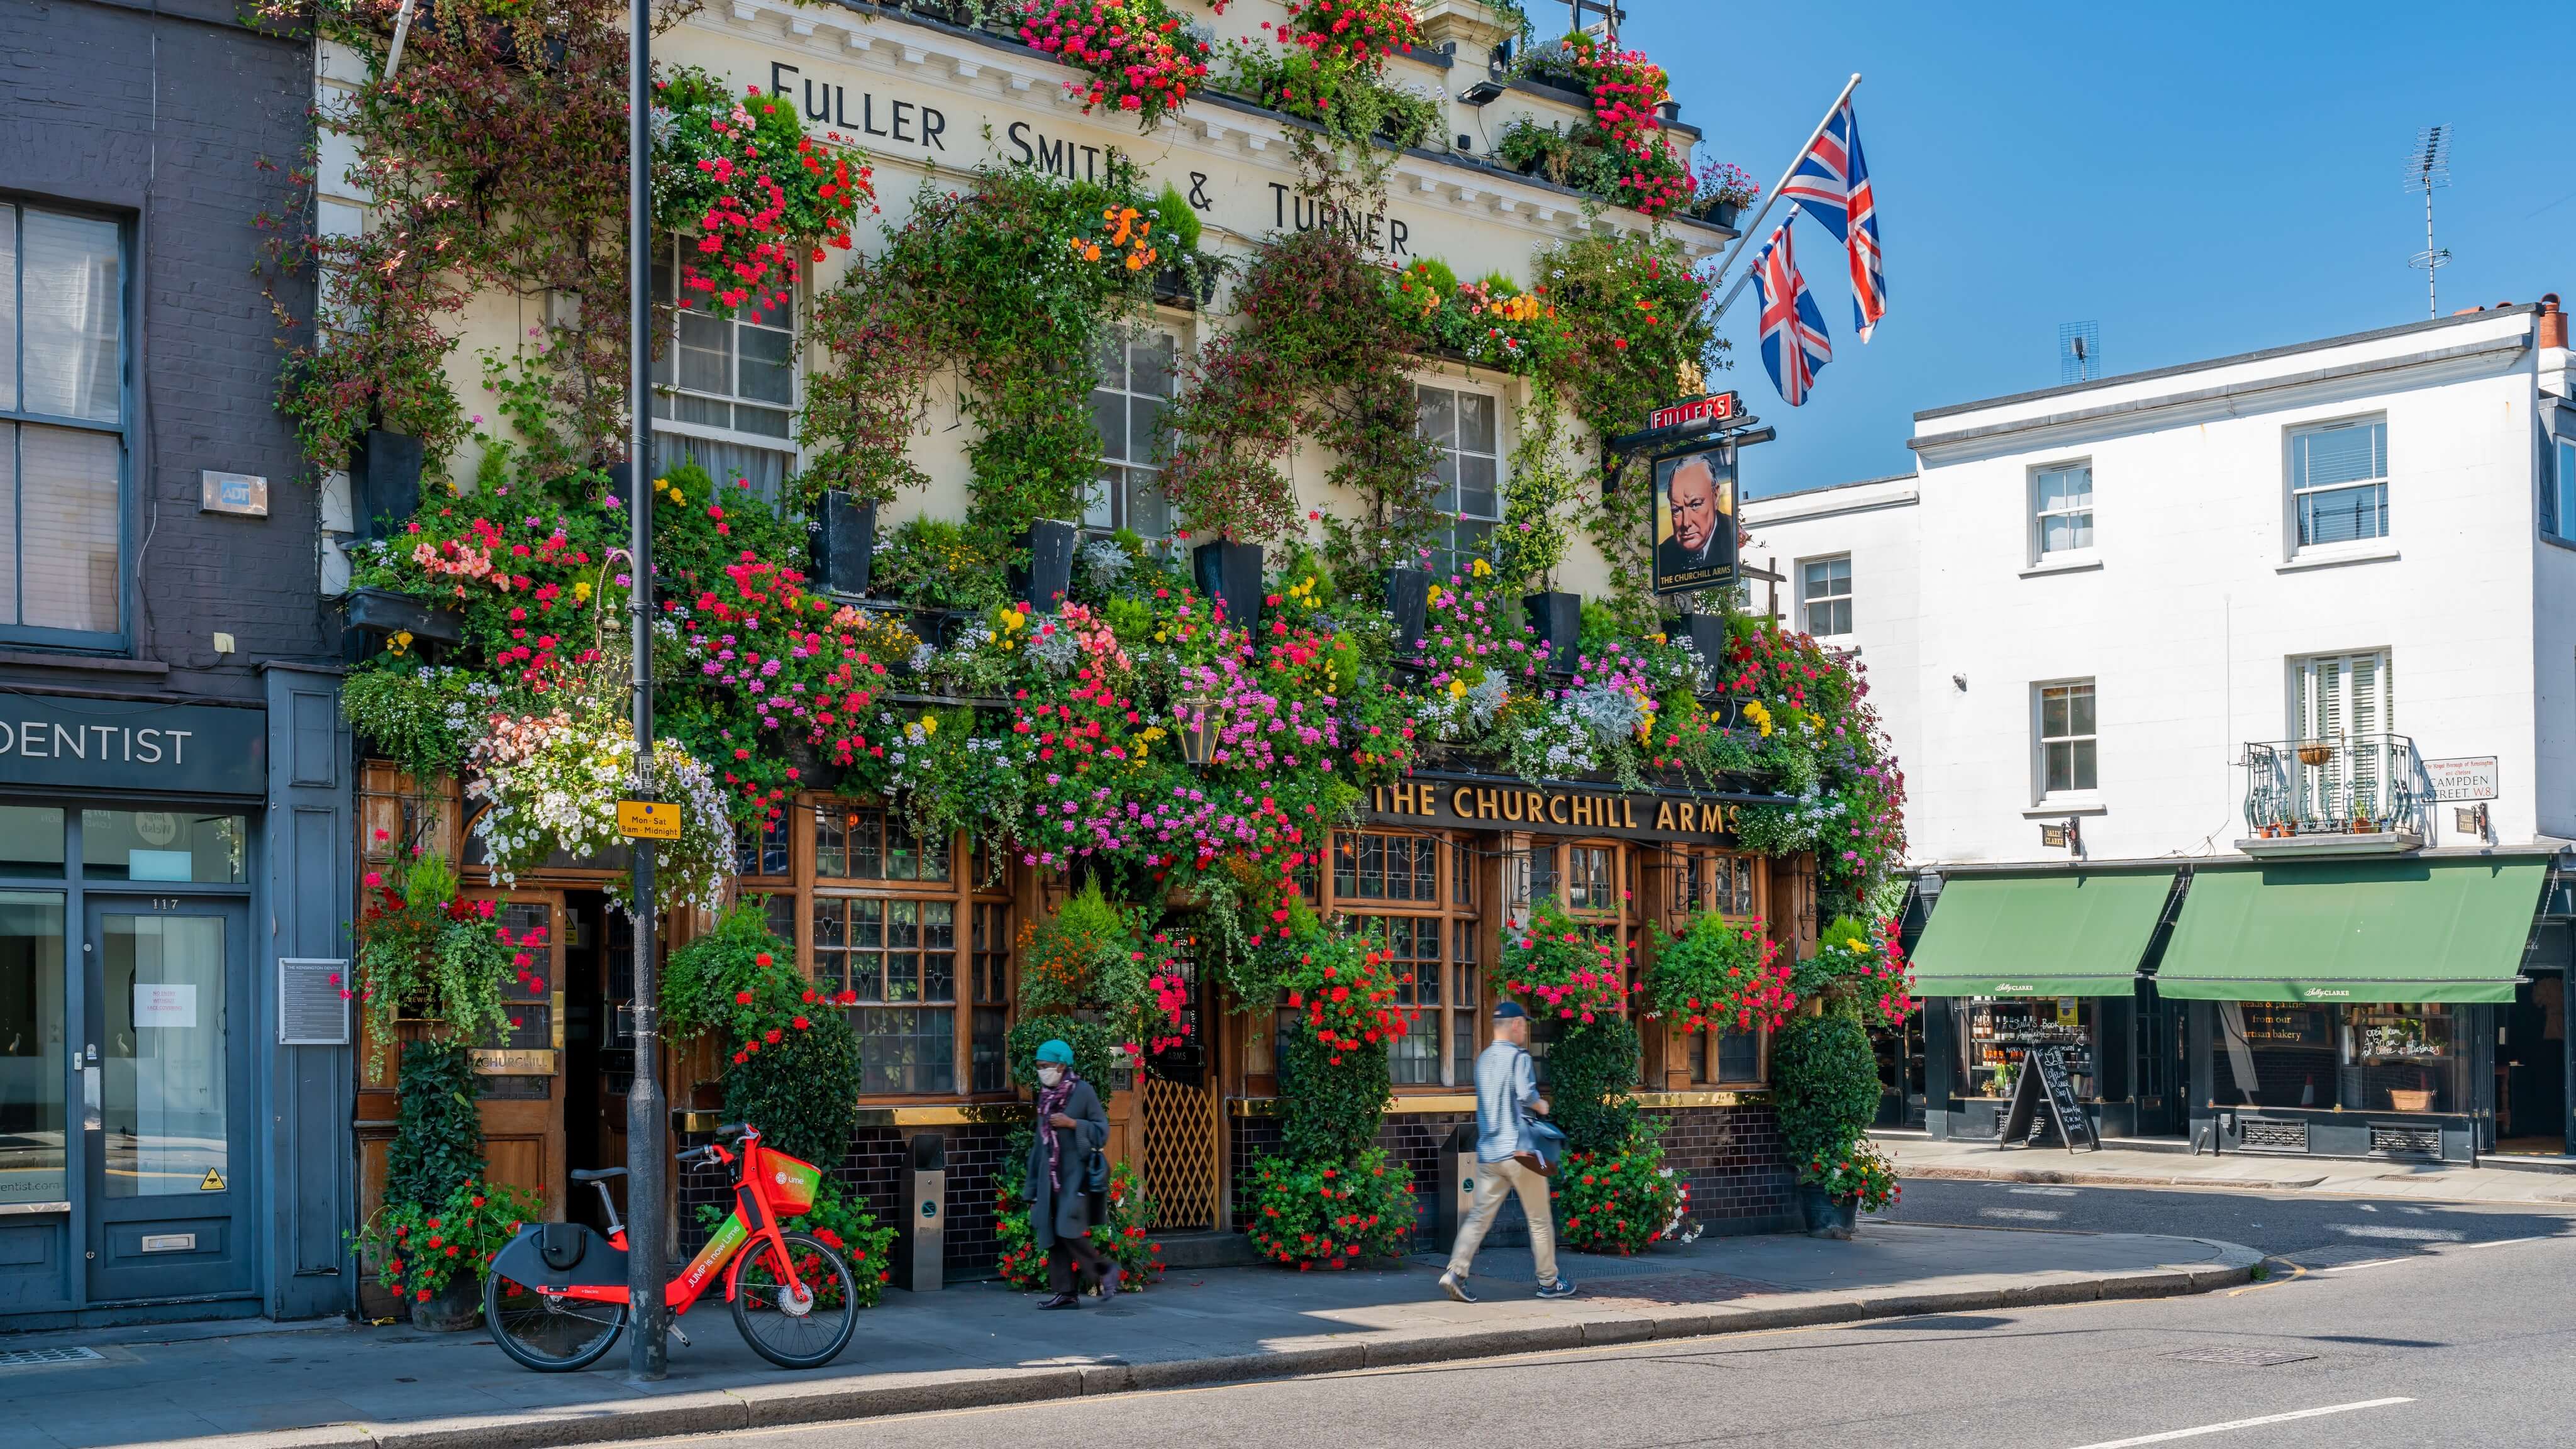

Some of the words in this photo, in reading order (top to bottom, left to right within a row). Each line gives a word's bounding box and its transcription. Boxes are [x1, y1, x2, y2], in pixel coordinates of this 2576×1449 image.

[771, 61, 945, 151] FULLER
[1189, 170, 1213, 211] &
[223, 487, 249, 501] ADT
[1661, 576, 1673, 584] THE
[1675, 569, 1711, 582] CHURCHILL
[1713, 565, 1731, 575] ARMS
[2428, 775, 2489, 787] CAMPDEN
[1372, 783, 1435, 815] THE
[1453, 787, 1637, 828] CHURCHILL
[1657, 800, 1741, 835] ARMS
[645, 827, 678, 836] Midnight
[2045, 837, 2063, 845] CLARKE
[153, 899, 179, 909] 117
[2276, 1001, 2307, 1011] patries
[2252, 1014, 2273, 1023] from
[2273, 1029, 2302, 1041] bakery
[481, 1057, 548, 1067] CHURCHILL
[1167, 1052, 1187, 1061] ARMS
[688, 1264, 706, 1289] JUMP
[704, 1258, 713, 1267] is
[711, 1242, 726, 1260] now
[722, 1225, 740, 1244] Lime
